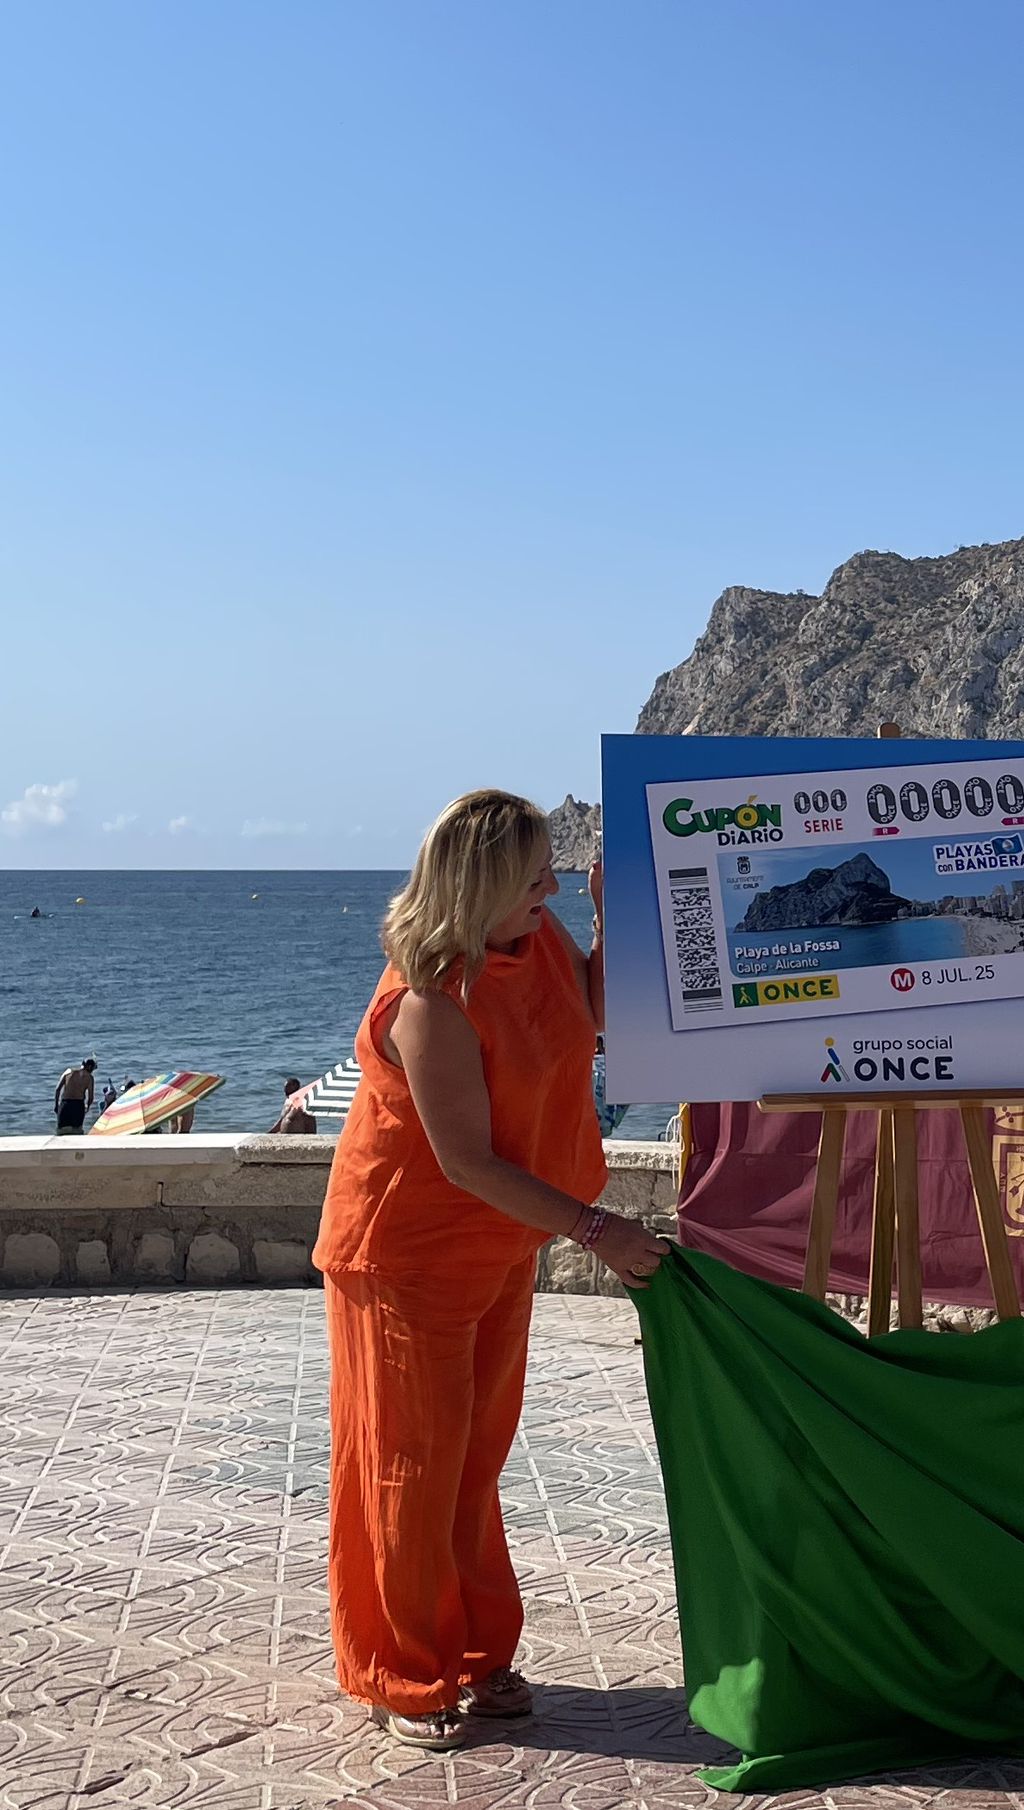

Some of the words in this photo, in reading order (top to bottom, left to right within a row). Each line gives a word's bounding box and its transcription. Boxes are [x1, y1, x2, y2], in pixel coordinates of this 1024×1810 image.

[793, 788, 848, 815] 000
[804, 818, 844, 834] SERIE
[936, 843, 993, 859] PLAYAS
[938, 863, 953, 873] con
[735, 946, 770, 960] Playa
[772, 944, 788, 955] de
[790, 942, 802, 954] la
[805, 939, 840, 953] Fossa
[737, 962, 767, 975] Calpe
[776, 957, 820, 971] Alicante
[894, 972, 911, 988] M
[922, 970, 932, 985] 8
[937, 967, 972, 984] JUL.
[975, 965, 995, 980] 25
[763, 978, 834, 1001] ONCE
[853, 1039, 902, 1054] grupo
[906, 1035, 953, 1050] social
[854, 1056, 954, 1081] ONCE
